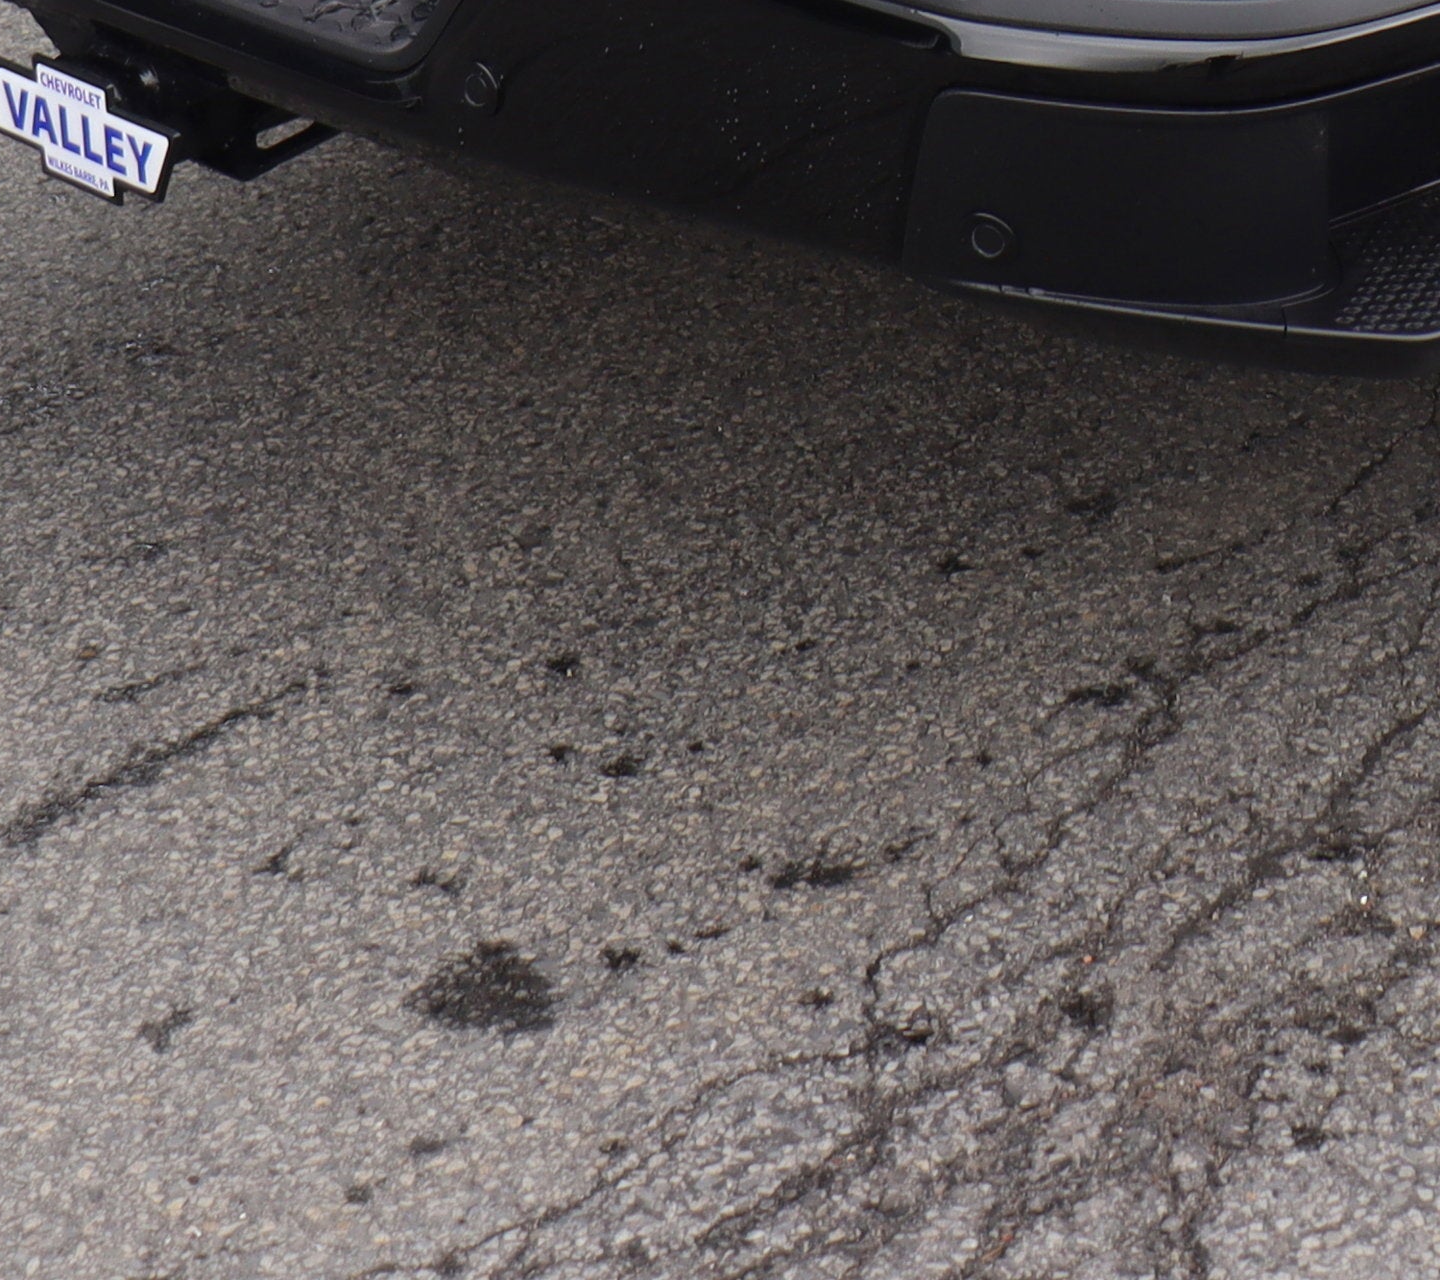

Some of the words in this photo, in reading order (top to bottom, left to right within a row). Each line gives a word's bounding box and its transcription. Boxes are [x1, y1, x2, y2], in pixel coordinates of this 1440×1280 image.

[40, 72, 101, 109] CHEVROLET
[1, 80, 154, 185] VALLEY
[48, 157, 73, 175] WILKES
[100, 180, 110, 191] PA
